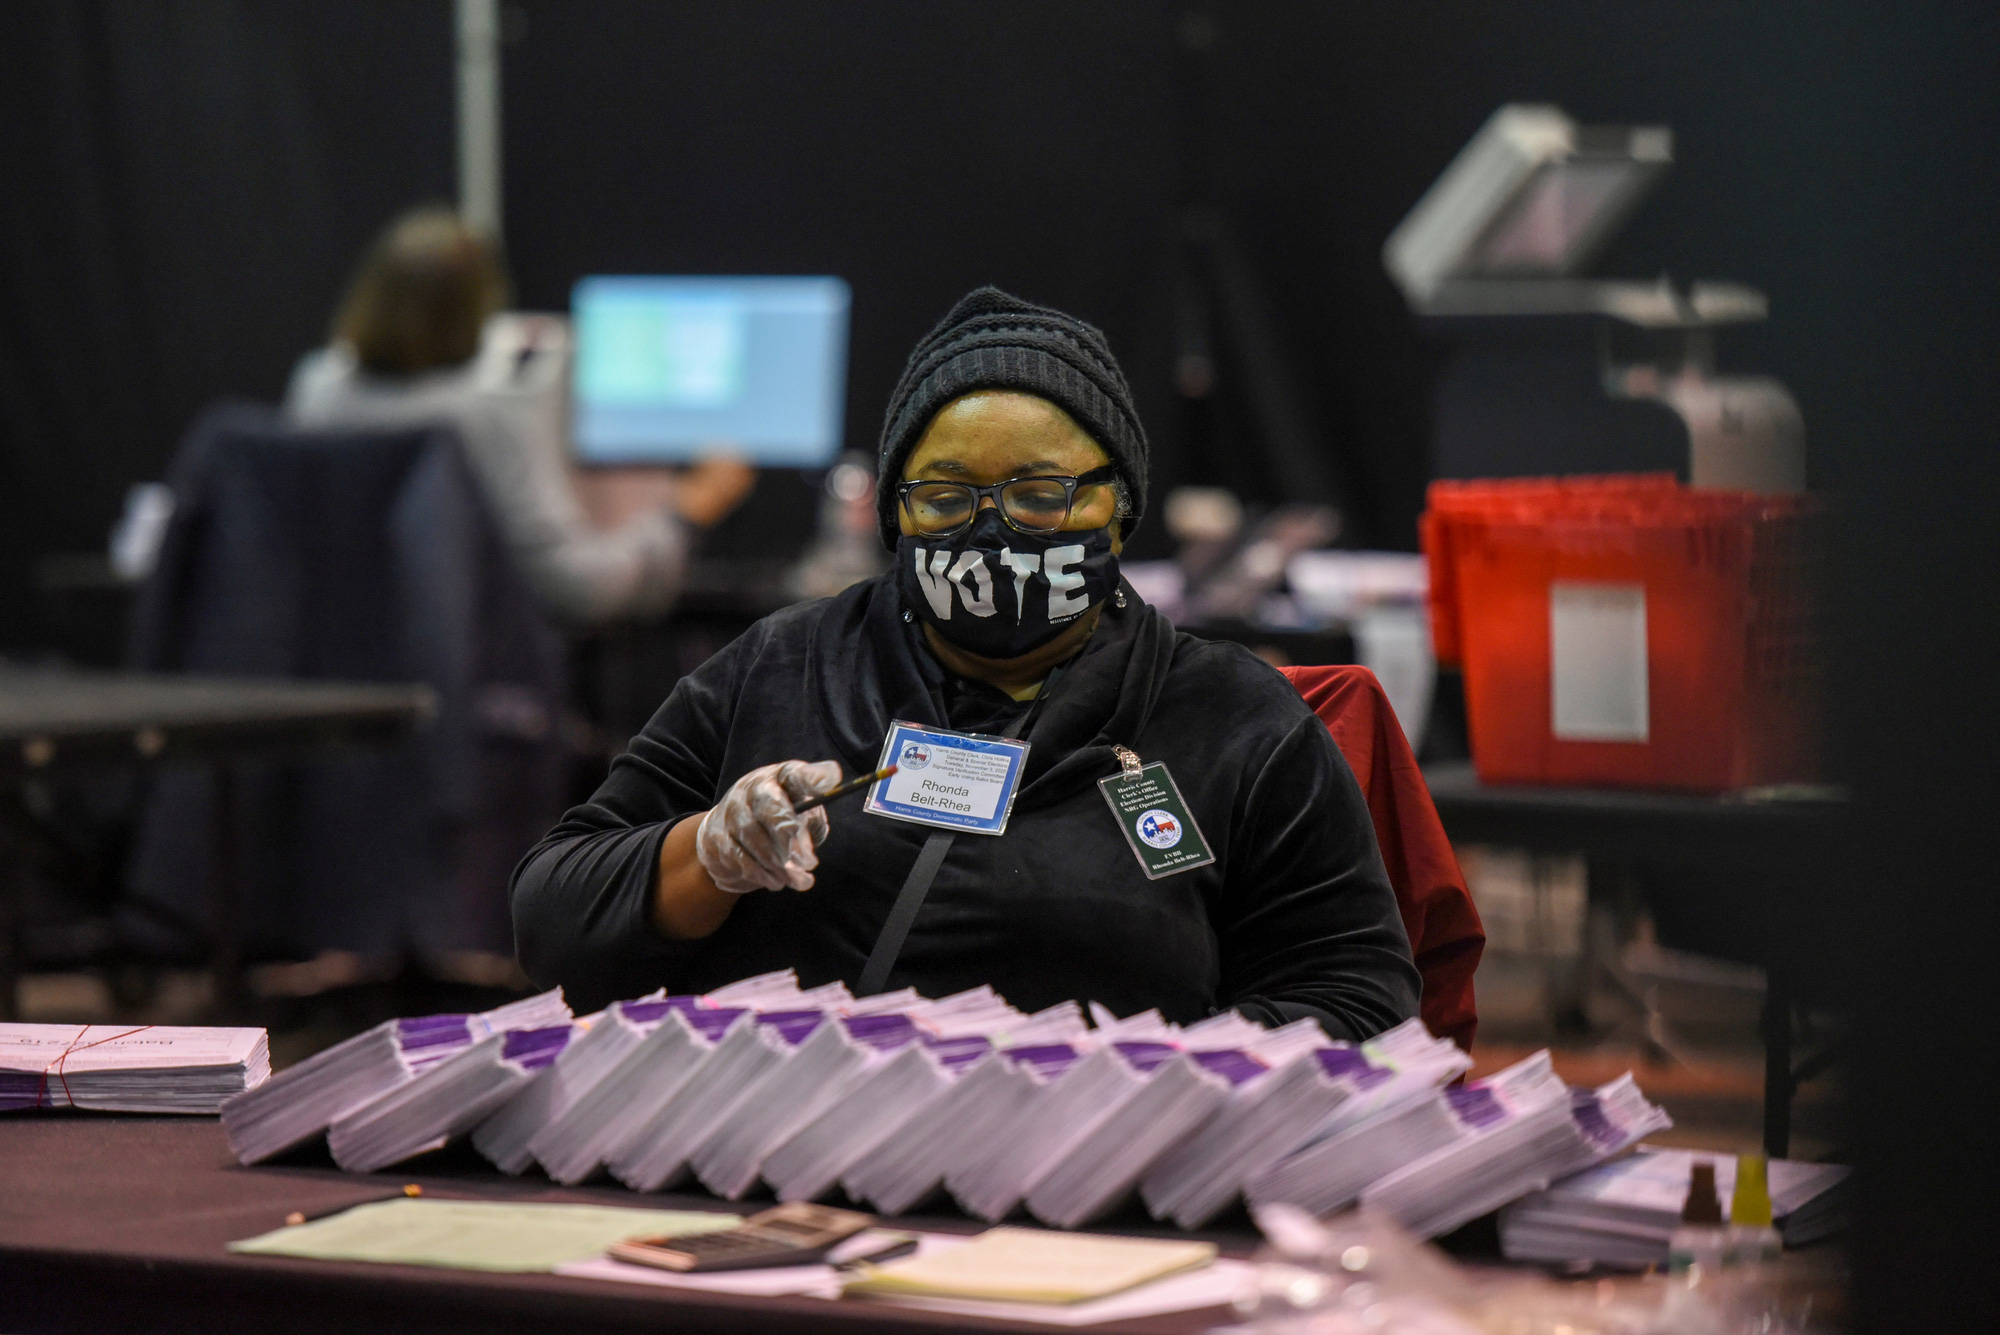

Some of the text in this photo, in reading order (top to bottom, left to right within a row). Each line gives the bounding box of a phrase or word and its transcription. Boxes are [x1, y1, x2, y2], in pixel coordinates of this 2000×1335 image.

[915, 544, 1090, 626] VOTE
[922, 780, 969, 796] Rhonda
[1117, 780, 1155, 793] Harris County
[911, 792, 971, 812] Belt-Rhea
[1120, 791, 1166, 807] Elections Division
[1122, 791, 1141, 799] Clerk's
[1139, 798, 1168, 808] Operations
[913, 809, 932, 818] County
[933, 812, 962, 822] Democratic
[1152, 853, 1200, 870] Rhonda Belt-Rhea
